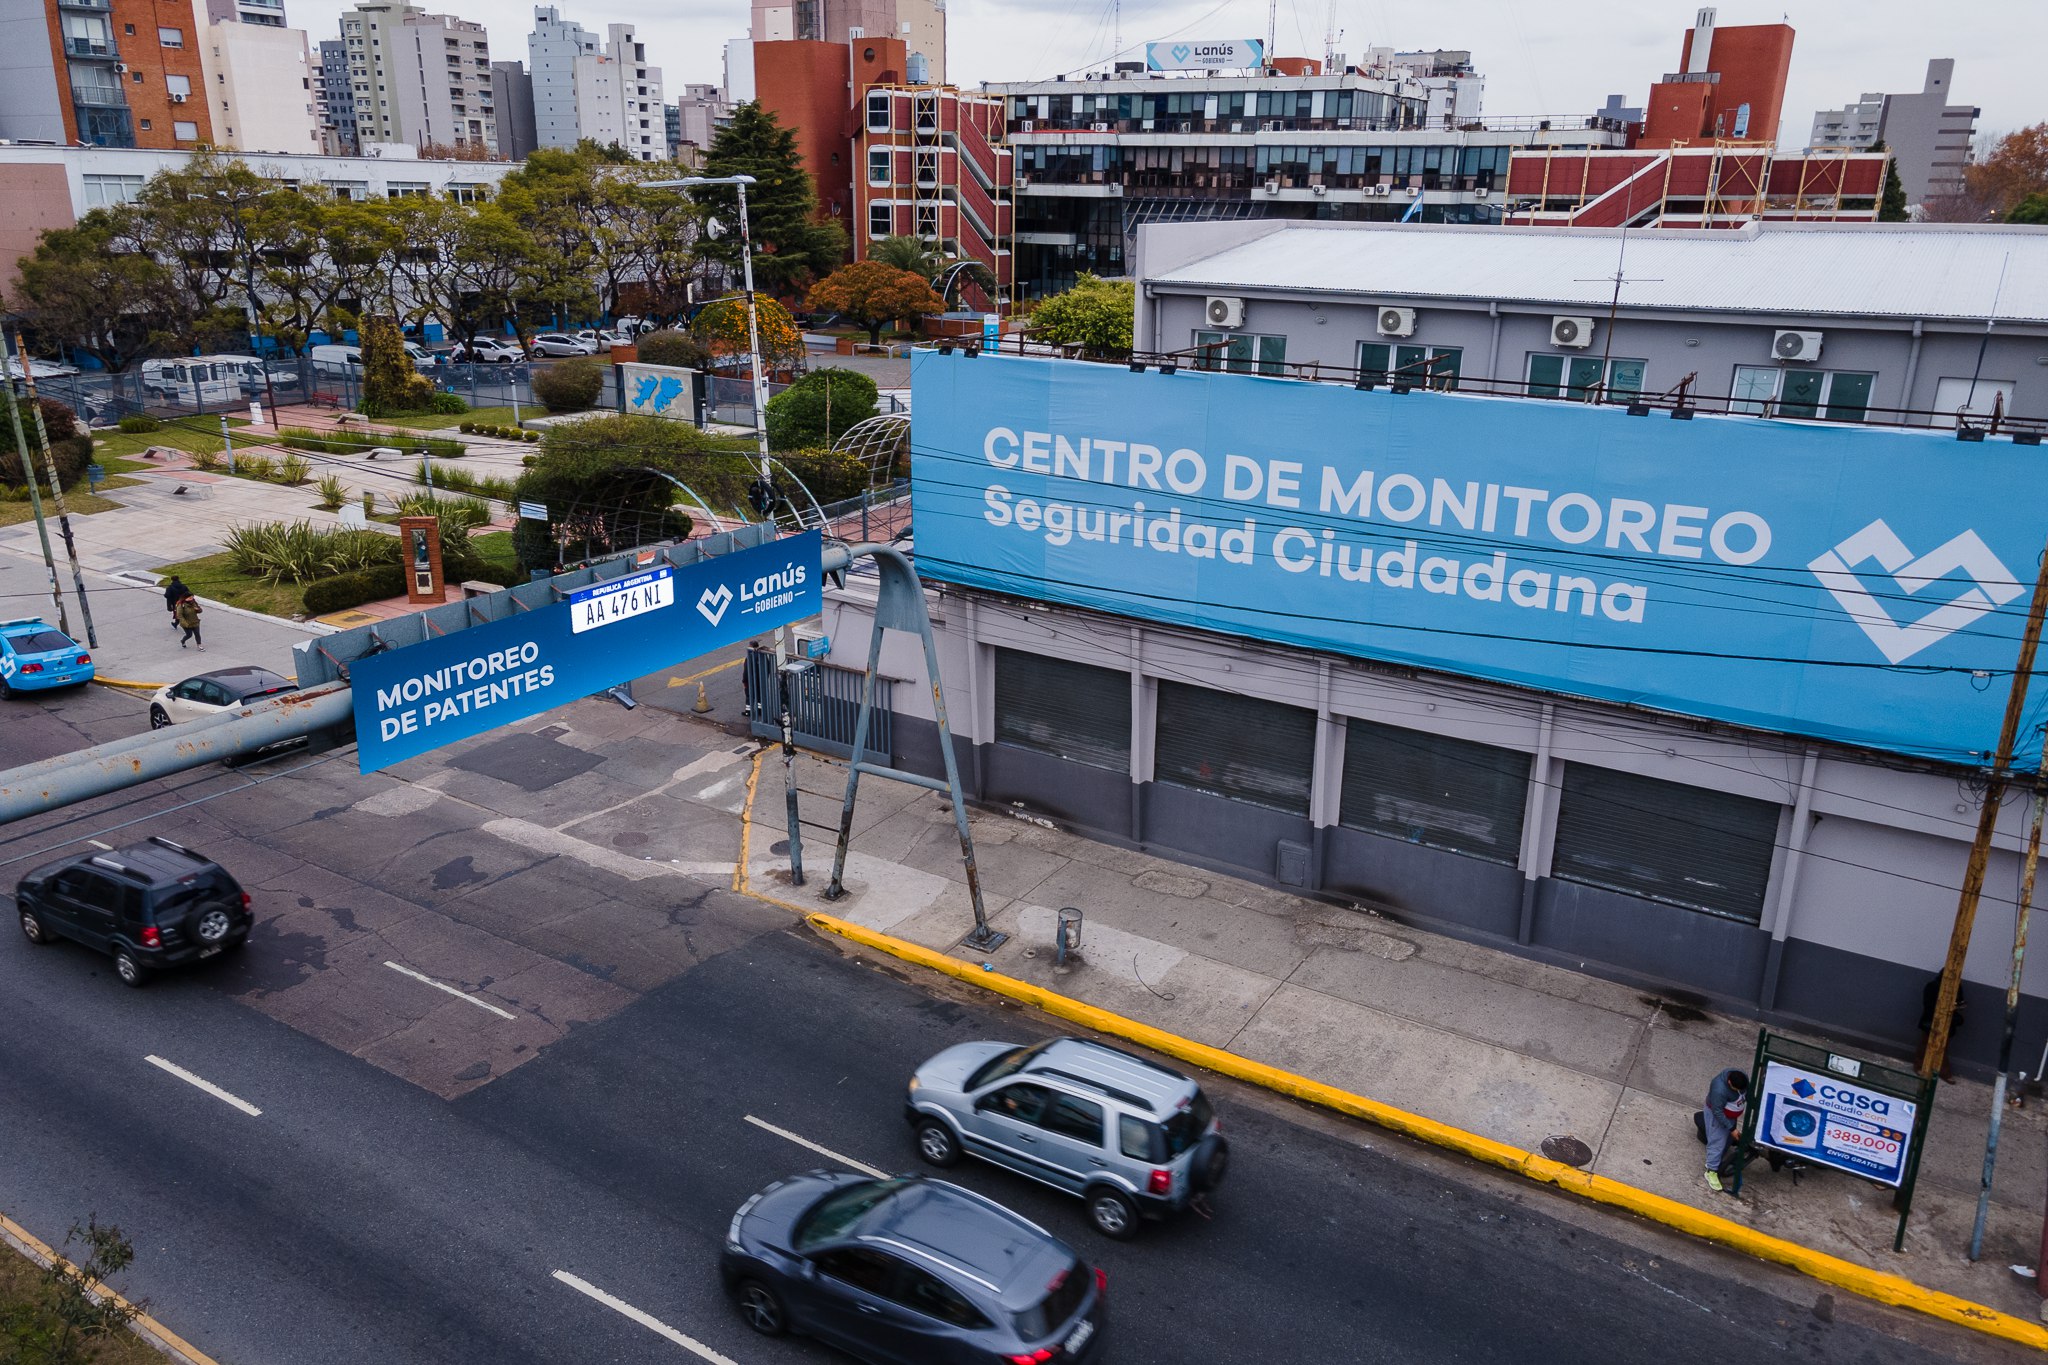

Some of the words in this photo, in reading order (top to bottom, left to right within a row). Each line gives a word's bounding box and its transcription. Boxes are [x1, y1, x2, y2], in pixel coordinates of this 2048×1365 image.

[1195, 43, 1233, 56] Lanús
[984, 427, 1207, 494] CENTRO
[1223, 454, 1303, 508] DE
[1319, 466, 1772, 565] MONITOREO
[984, 485, 1256, 565] Seguridad
[1272, 527, 1648, 624] Ciudadana
[623, 574, 653, 589] ARGENTINA
[740, 562, 806, 601] Lanús
[587, 600, 605, 625] AA
[612, 590, 638, 616] 476
[644, 584, 661, 607] NI
[755, 591, 793, 614] GOBIERNO
[376, 641, 539, 712] MONITOREO
[380, 710, 419, 743] DE
[424, 664, 556, 727] PATENTES
[1818, 1098, 1887, 1124] delaudio.com
[1819, 1085, 1890, 1116] casa
[1826, 1129, 1897, 1153] $389.000
[1850, 1156, 1878, 1169] GRATIS
